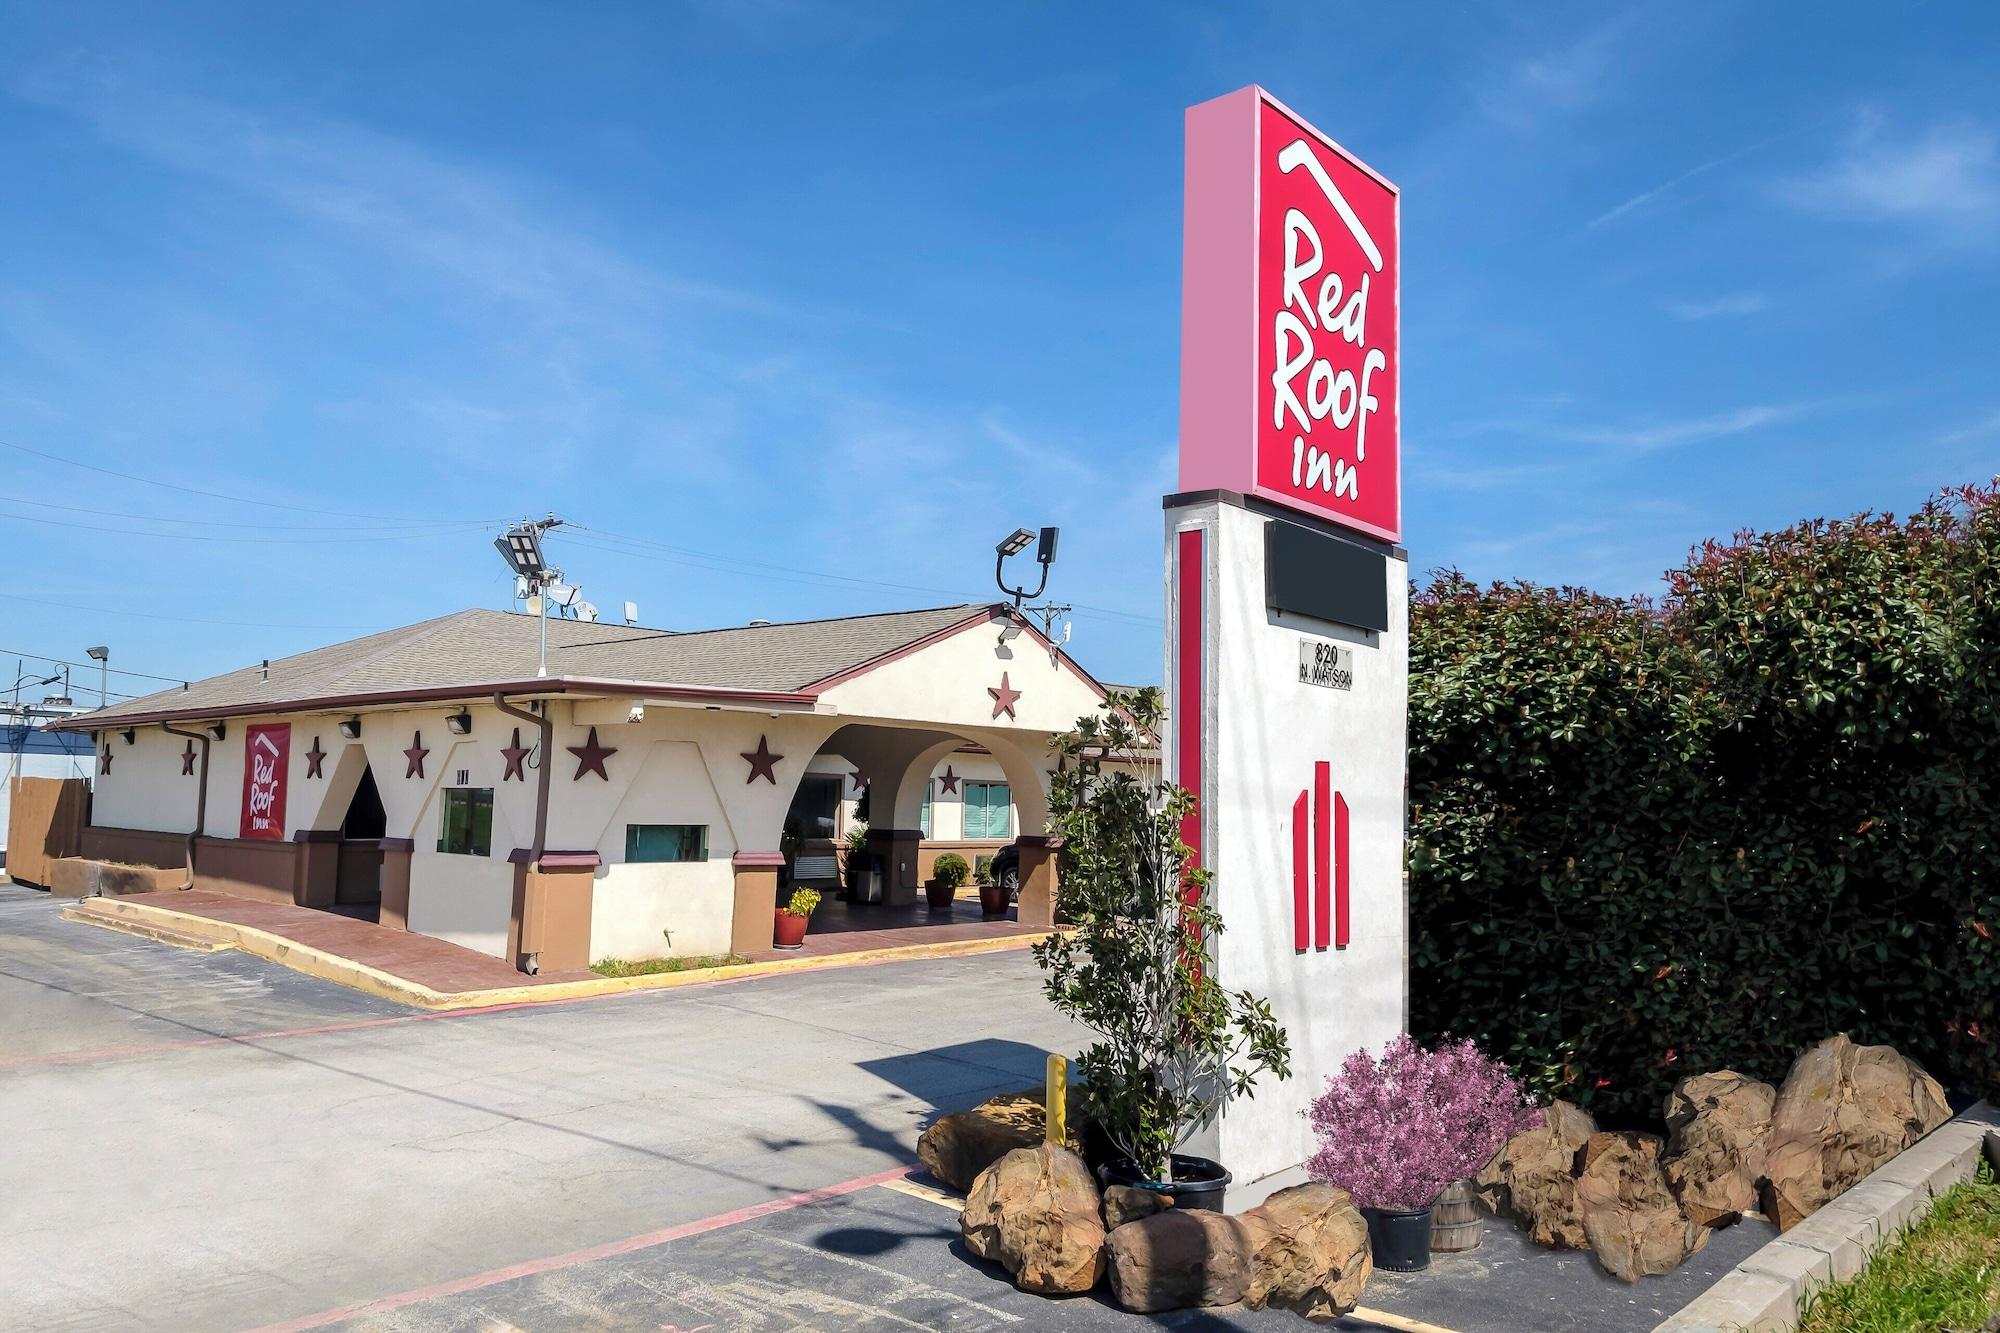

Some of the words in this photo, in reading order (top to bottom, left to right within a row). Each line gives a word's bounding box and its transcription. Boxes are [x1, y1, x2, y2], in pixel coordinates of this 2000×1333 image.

[1283, 207, 1369, 348] Red
[1272, 310, 1385, 461] Roof
[1292, 435, 1358, 501] Inn
[1315, 643, 1338, 666] 820
[1301, 662, 1310, 679] N.
[1312, 664, 1352, 686] WATSON
[253, 754, 275, 784] Red
[250, 780, 278, 817] Roof
